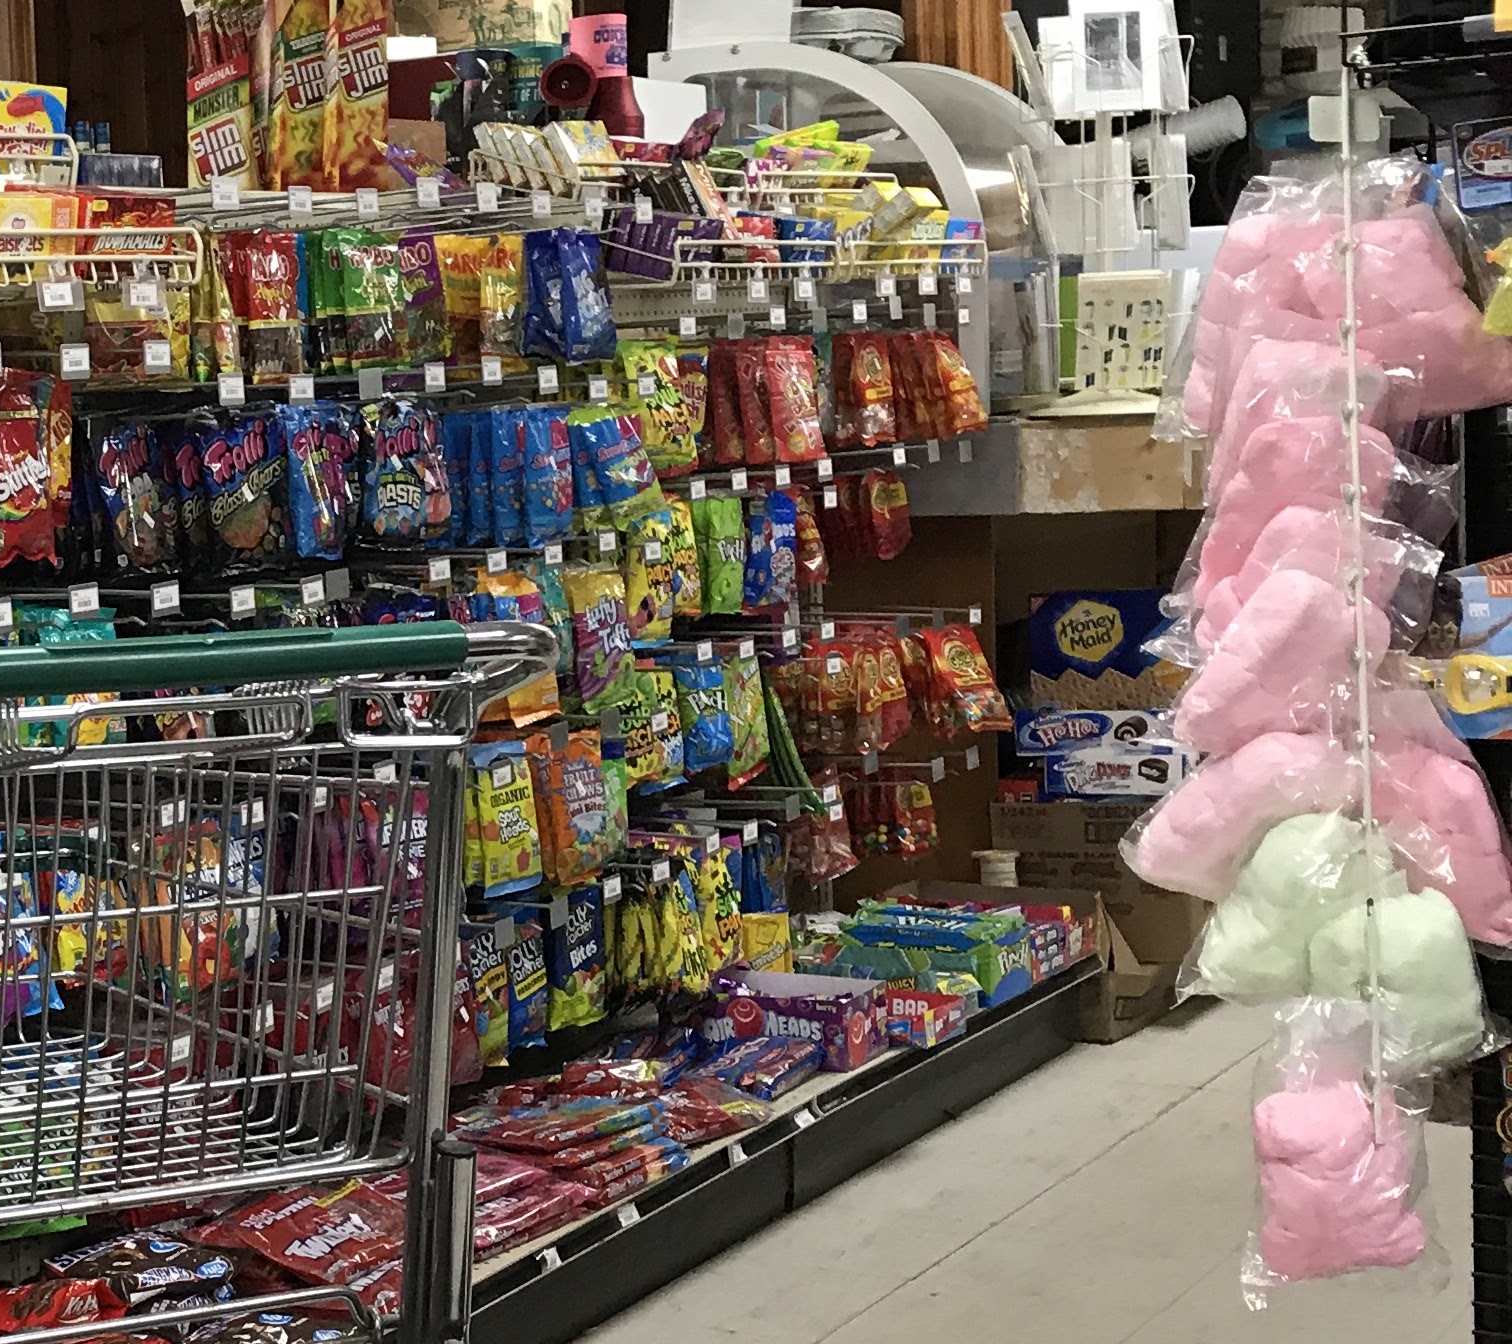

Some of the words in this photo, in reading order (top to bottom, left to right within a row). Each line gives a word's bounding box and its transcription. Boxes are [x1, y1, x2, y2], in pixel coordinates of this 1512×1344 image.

[345, 23, 382, 42] ORIGINAL
[194, 63, 238, 92] ORIGINAL
[1059, 612, 1118, 639] Honey
[1069, 628, 1113, 652] Maid
[489, 785, 531, 808] ORGANIC
[497, 805, 522, 828] Sour
[499, 820, 531, 845] Heads
[569, 939, 598, 969] Bites
[892, 998, 929, 1016] BAR
[704, 1016, 735, 1042] AIR
[764, 1010, 823, 1042] HEADS
